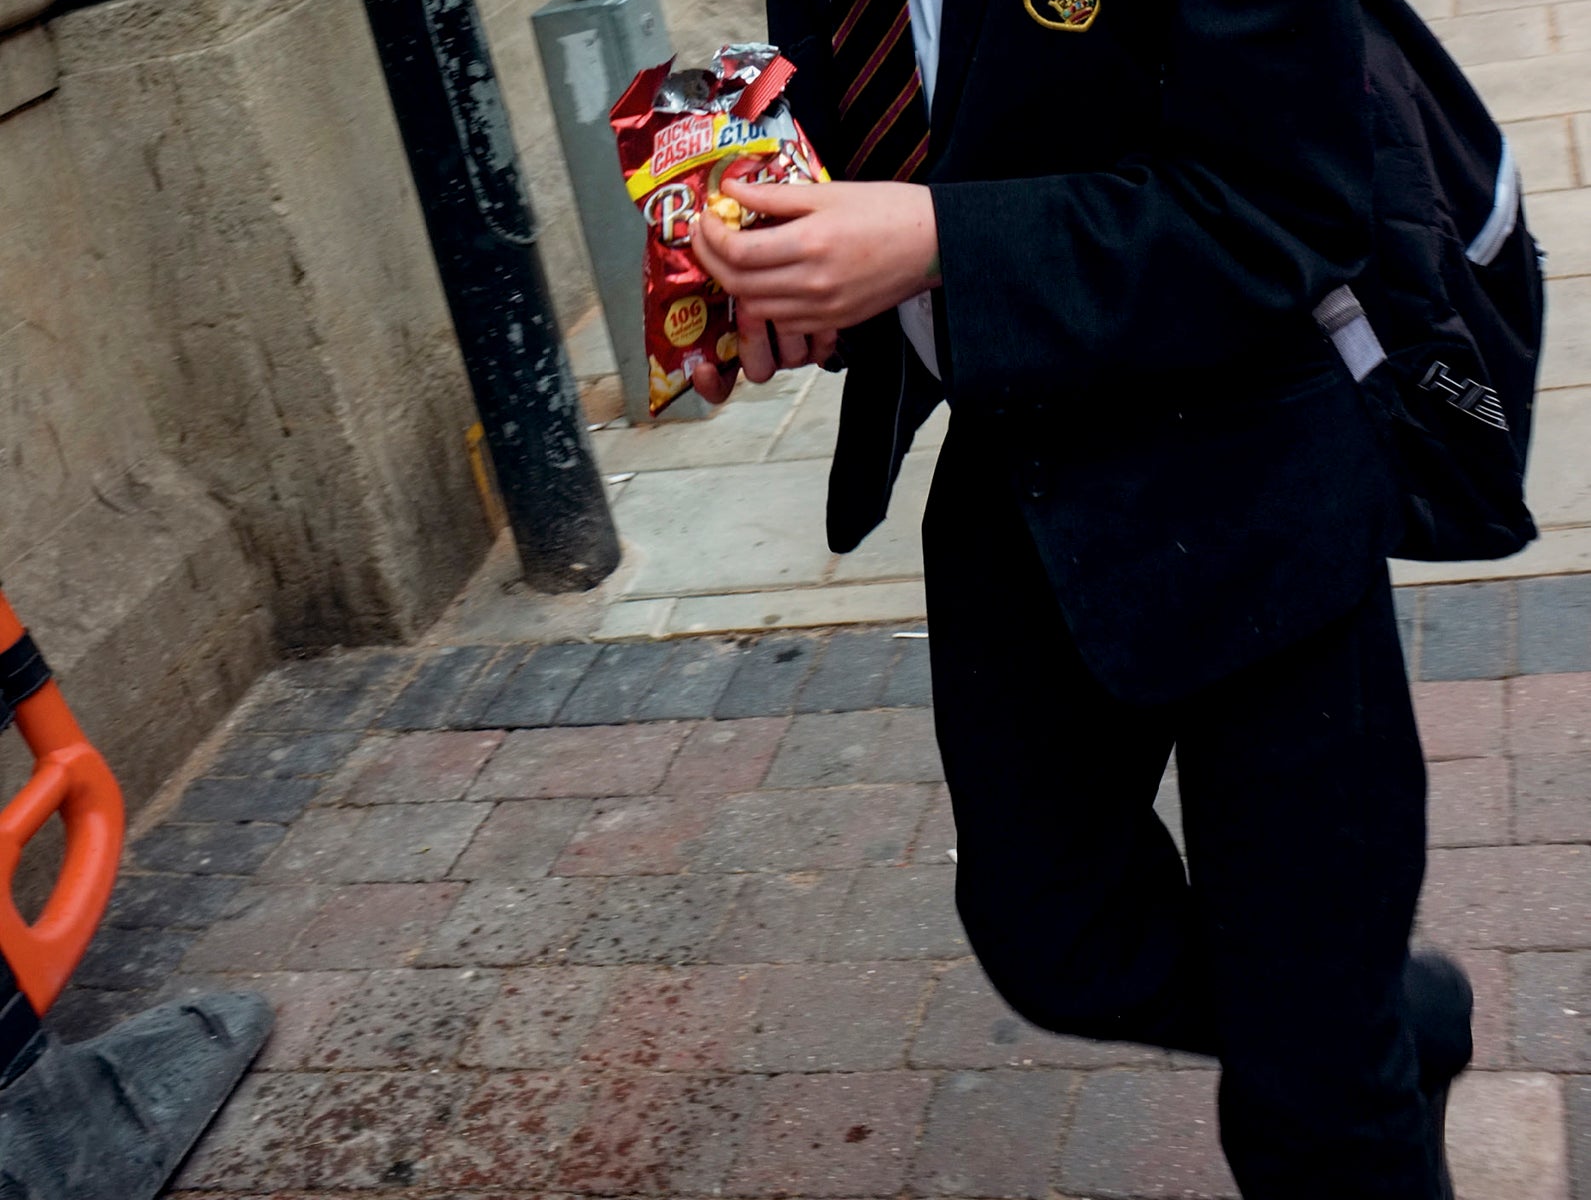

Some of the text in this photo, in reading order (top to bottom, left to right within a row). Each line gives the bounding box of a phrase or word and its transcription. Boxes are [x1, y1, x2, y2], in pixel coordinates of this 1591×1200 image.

[656, 116, 692, 150] KICK
[653, 129, 711, 175] CASH!
[670, 299, 702, 328] 106
